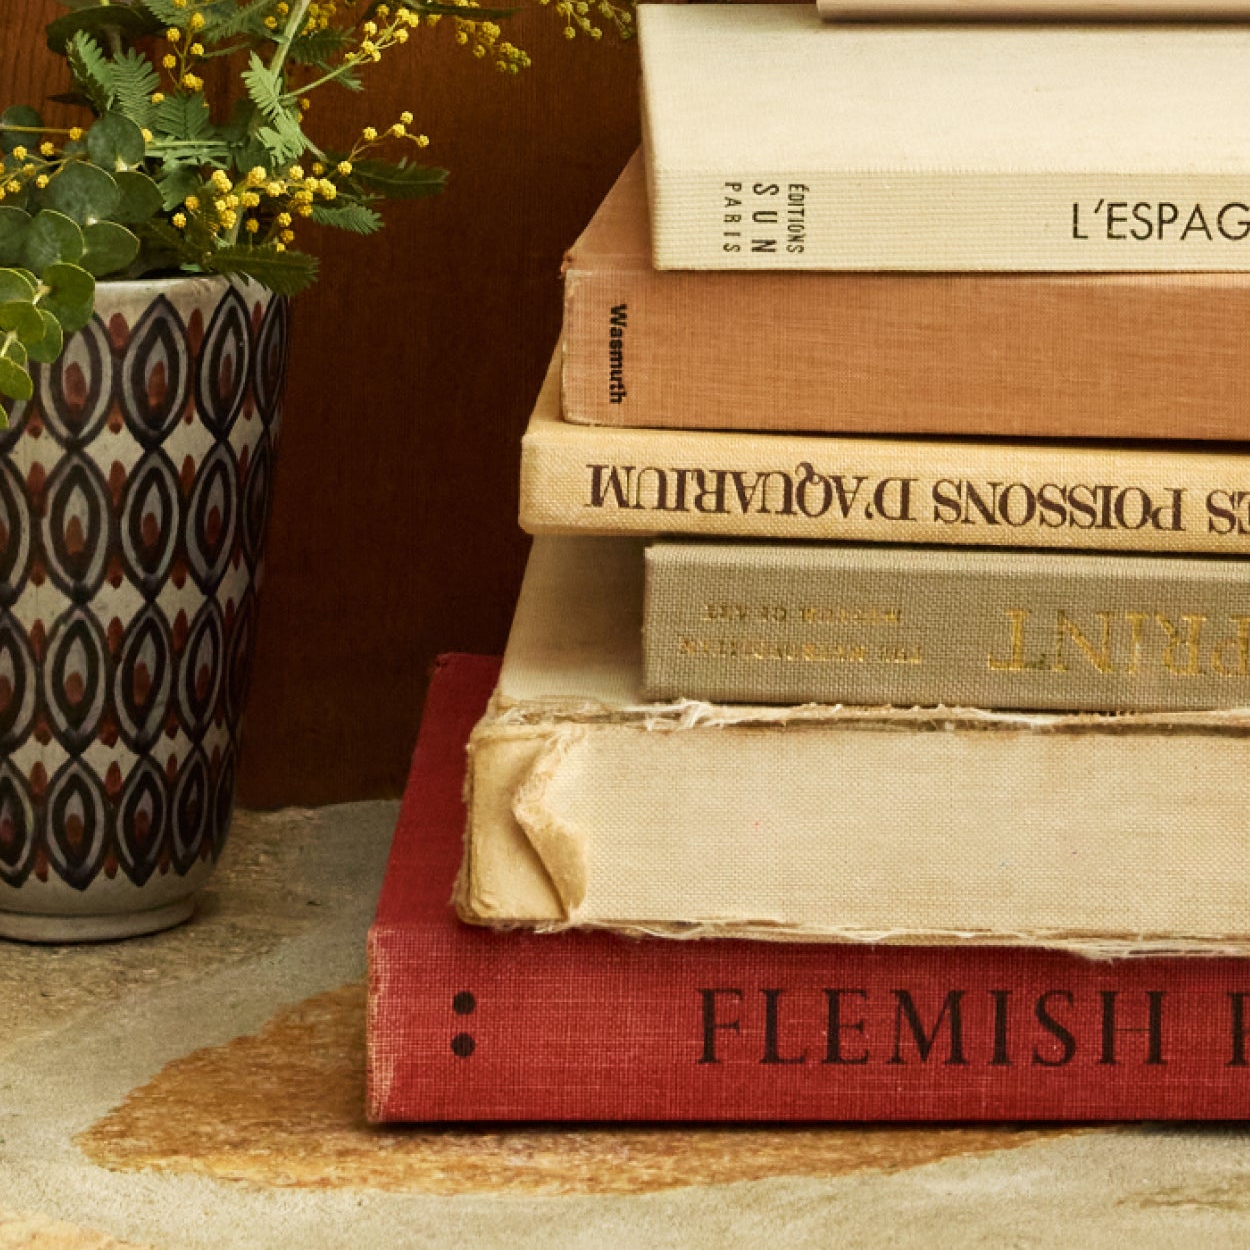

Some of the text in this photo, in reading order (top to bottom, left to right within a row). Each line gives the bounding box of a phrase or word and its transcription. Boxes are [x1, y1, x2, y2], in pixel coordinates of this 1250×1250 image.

[722, 181, 743, 253] PARIS
[751, 183, 780, 253] SUN
[608, 303, 628, 405] Wasmuth
[585, 461, 919, 521] D'AQUARIUM
[932, 478, 1188, 531] POISSONS
[696, 987, 1168, 1068] FLEMISH
